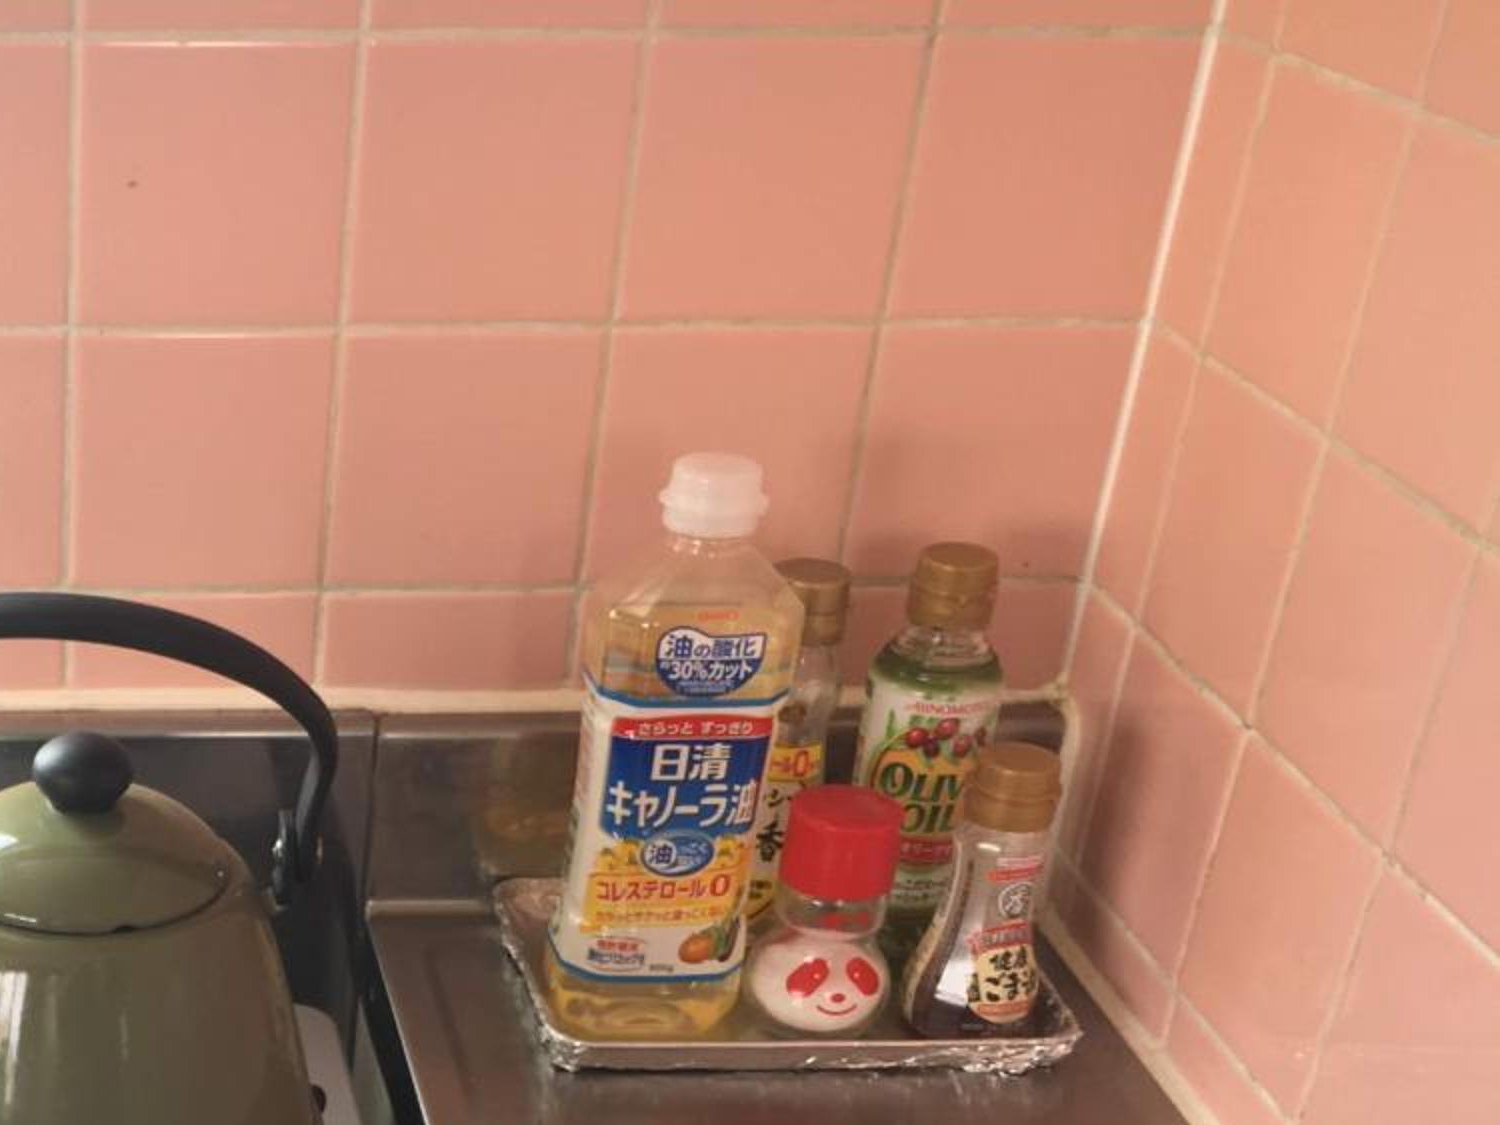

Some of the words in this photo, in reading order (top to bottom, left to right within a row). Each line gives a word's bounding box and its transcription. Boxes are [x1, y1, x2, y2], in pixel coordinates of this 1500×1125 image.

[665, 634, 756, 658] 油の酸化
[637, 721, 694, 736] さらっと
[700, 719, 754, 735] すっきり
[651, 743, 732, 781] 日清
[880, 762, 964, 801] OLIV
[605, 780, 752, 828] キャノーラ油
